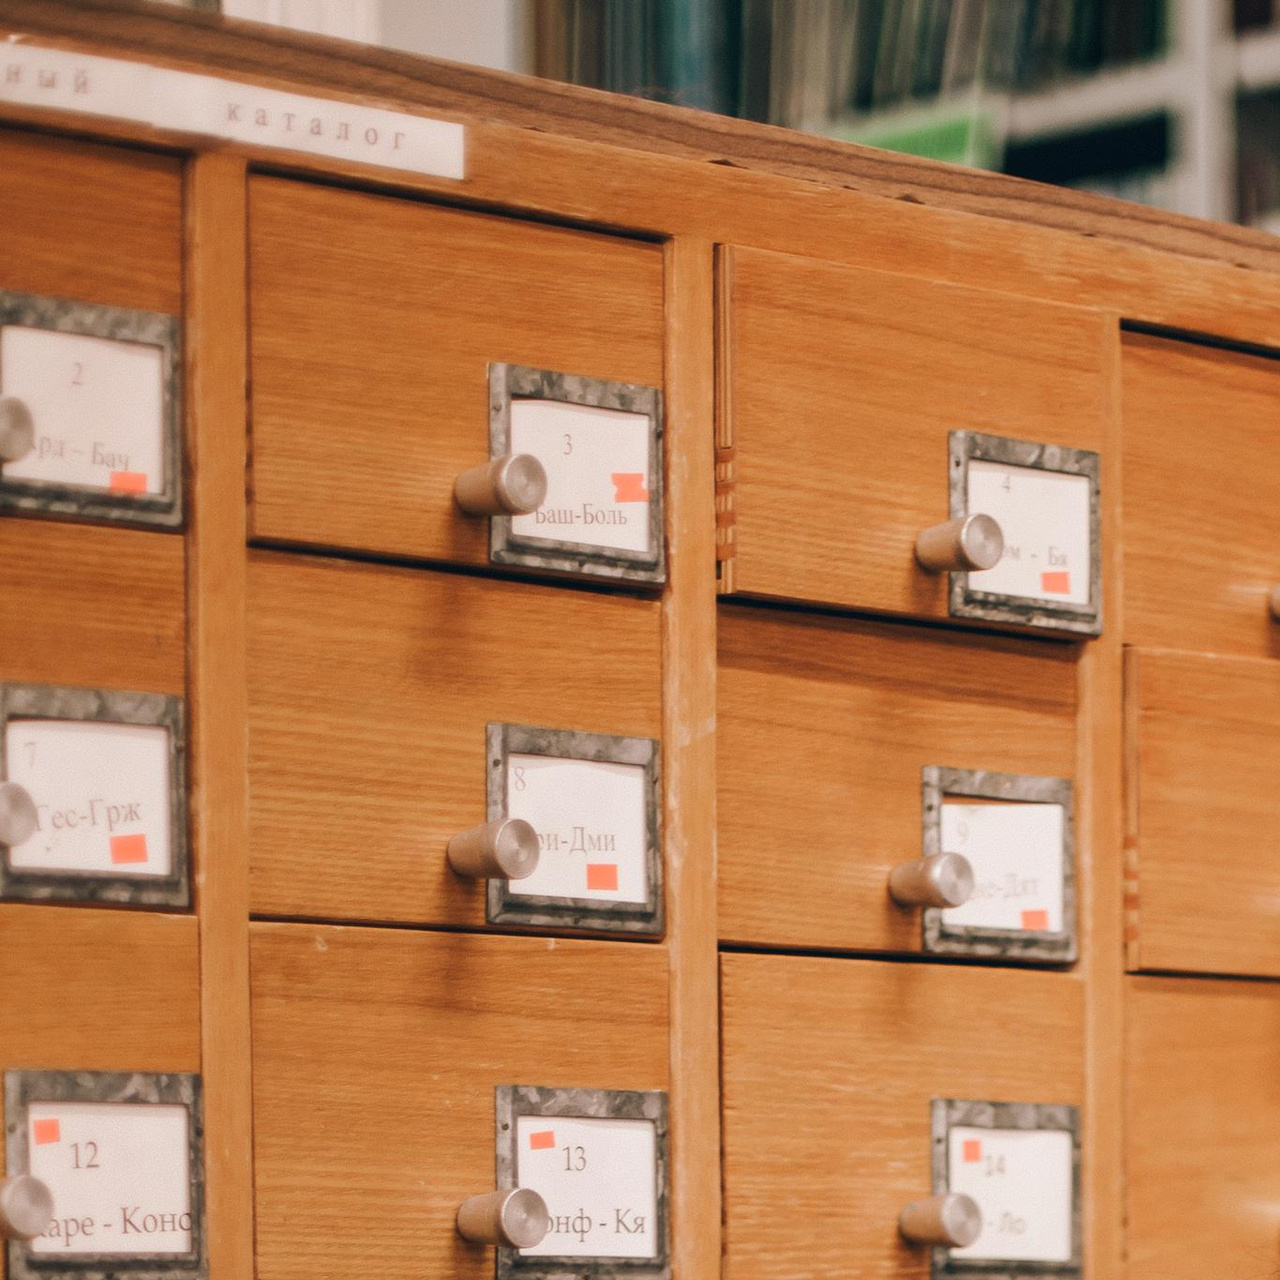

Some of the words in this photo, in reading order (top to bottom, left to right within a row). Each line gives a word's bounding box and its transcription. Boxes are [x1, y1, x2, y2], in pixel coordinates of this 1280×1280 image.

[226, 101, 405, 150] каталог
[71, 360, 83, 386] 2
[563, 433, 573, 456] 3
[24, 740, 36, 769] 7
[514, 765, 527, 792] 8
[36, 798, 142, 833] Гес-Грж
[70, 1140, 100, 1170] 12
[562, 1145, 588, 1172] 13
[38, 1214, 95, 1248] аре
[614, 1207, 647, 1234] Кя
